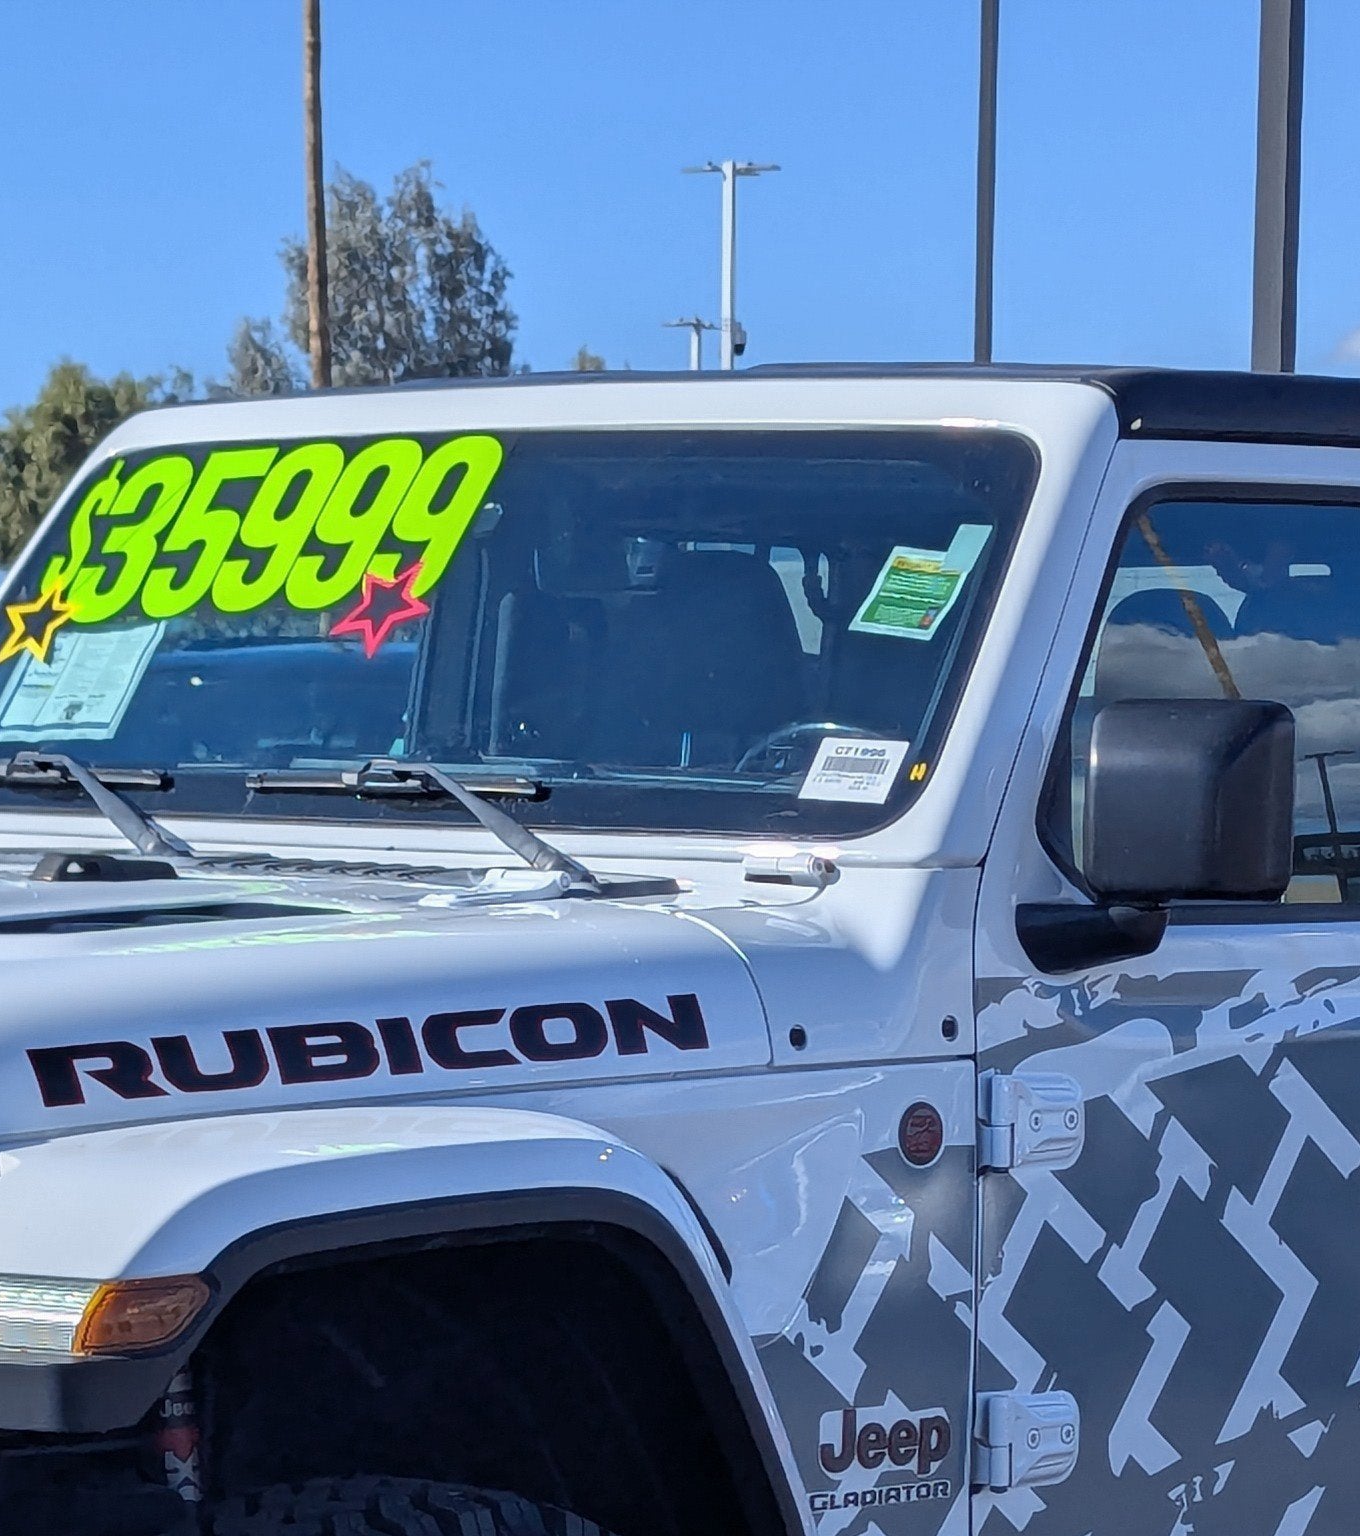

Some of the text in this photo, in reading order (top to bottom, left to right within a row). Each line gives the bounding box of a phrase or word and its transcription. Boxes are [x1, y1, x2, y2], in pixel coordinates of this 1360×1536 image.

[41, 434, 505, 625] $35999
[25, 992, 710, 1108] RUBICON
[820, 1408, 951, 1475] Jeep
[809, 1480, 949, 1512] GLADIATOR
